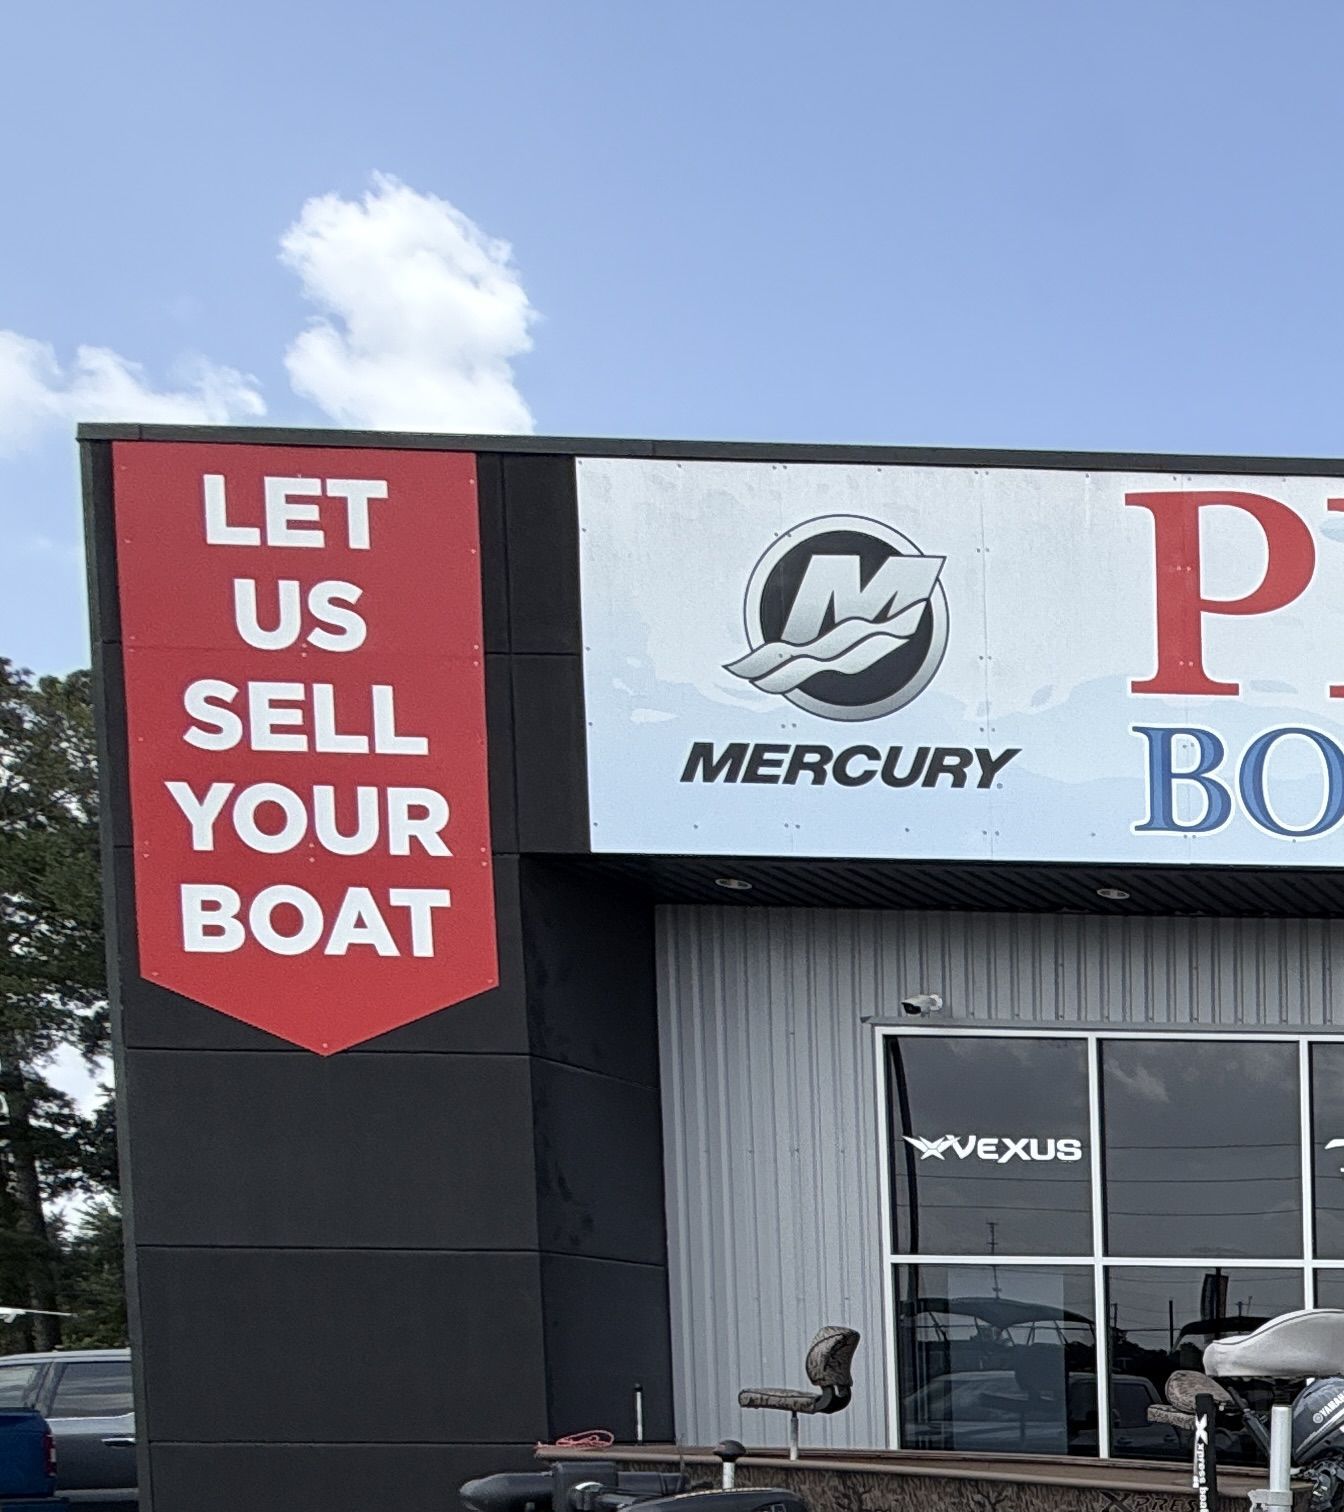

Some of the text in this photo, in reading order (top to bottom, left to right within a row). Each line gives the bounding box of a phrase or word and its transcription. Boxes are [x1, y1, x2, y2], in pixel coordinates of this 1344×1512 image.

[203, 473, 389, 549] LET
[233, 578, 367, 653] US
[183, 679, 428, 755] SELL
[680, 742, 1023, 789] MERCURY
[164, 781, 453, 856] YOUR
[180, 884, 452, 957] BOAT
[945, 1134, 1082, 1164] VEXUS
